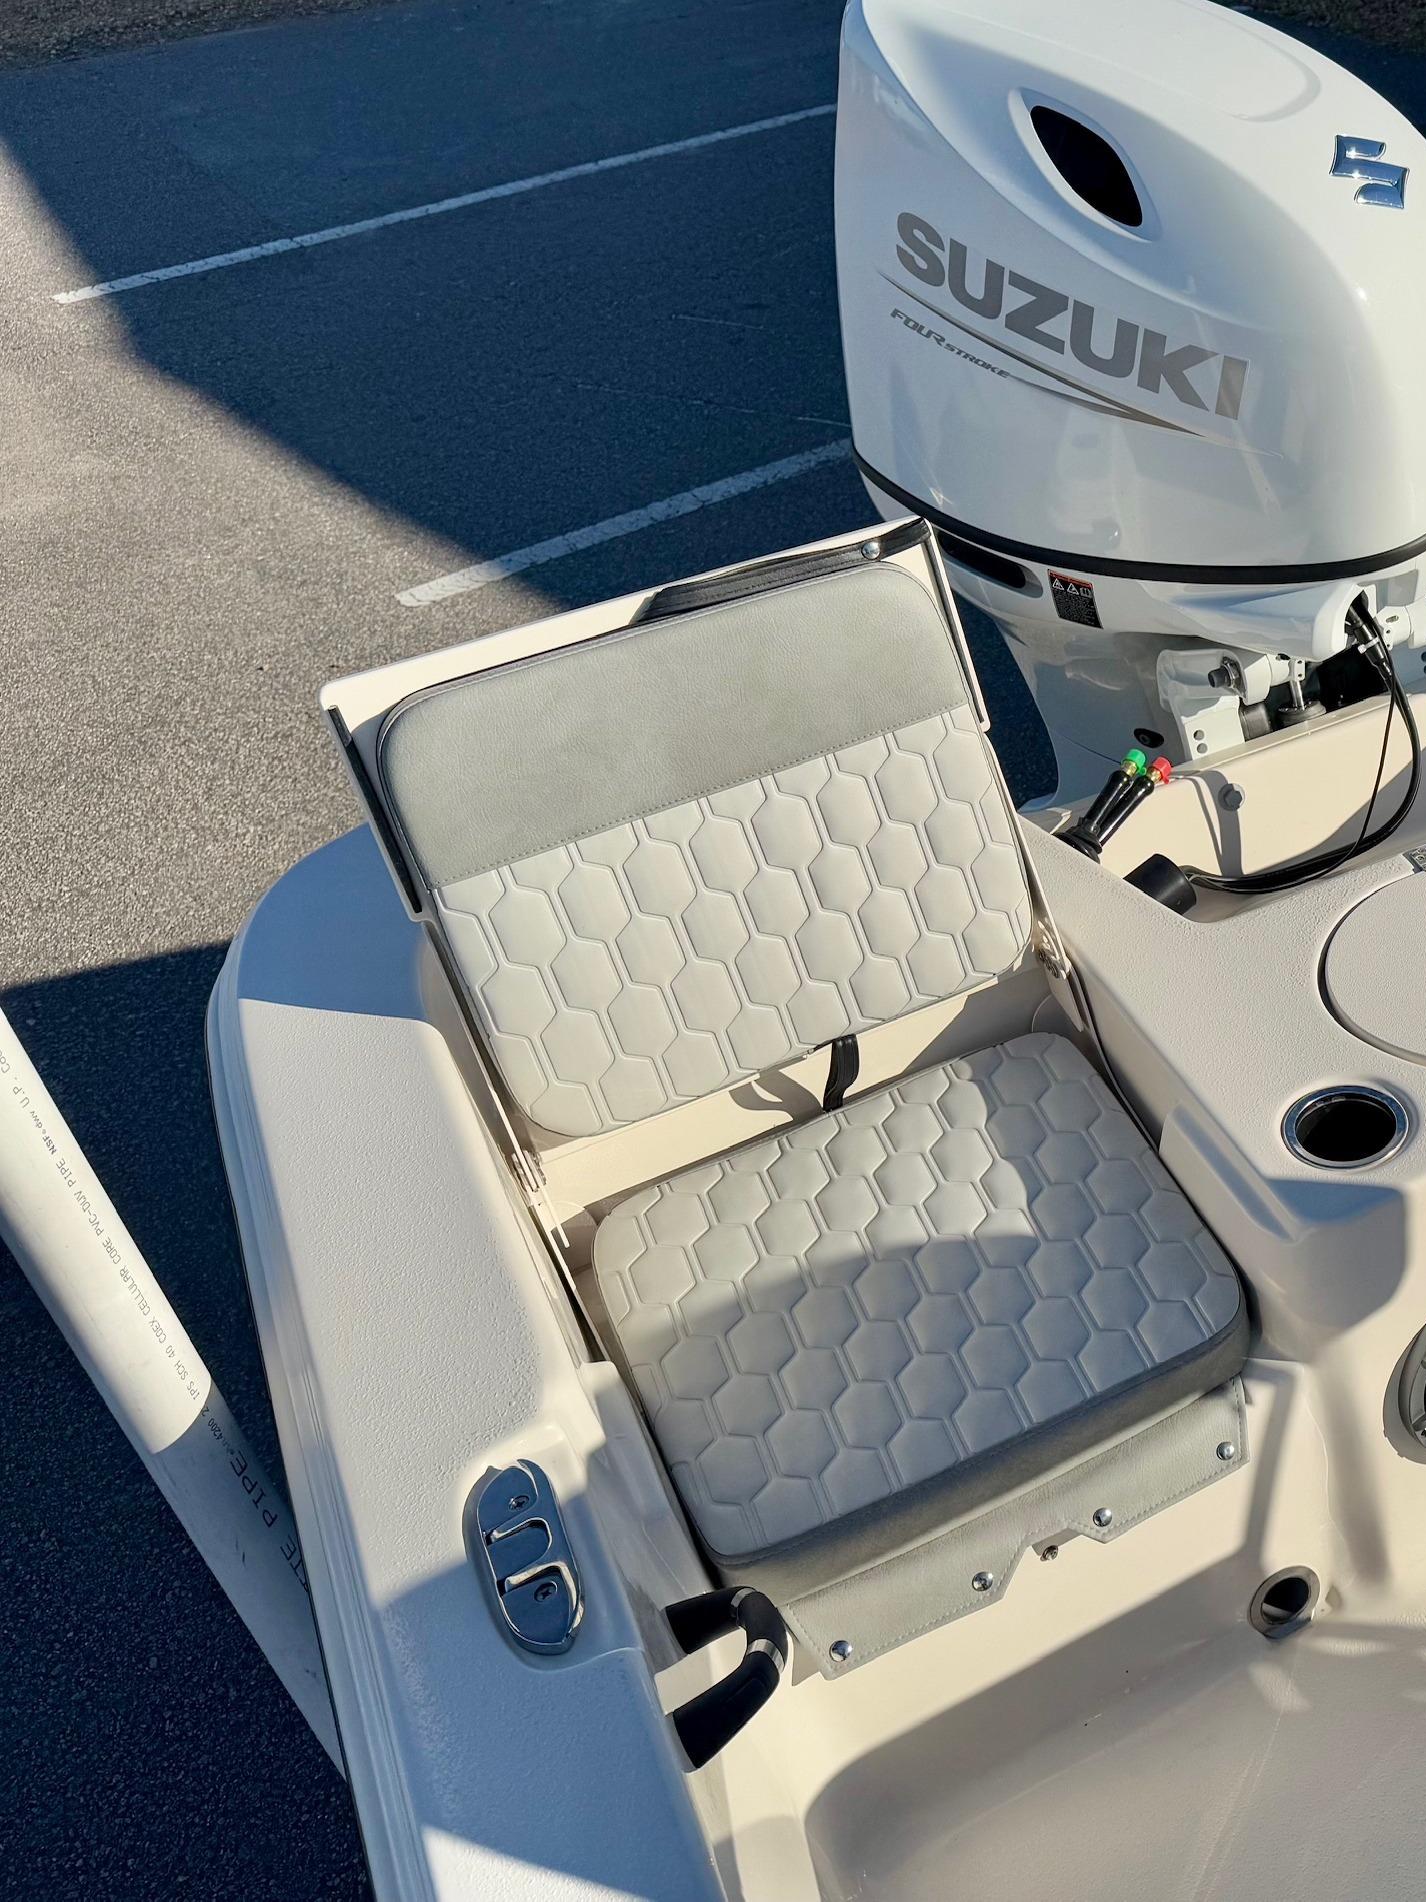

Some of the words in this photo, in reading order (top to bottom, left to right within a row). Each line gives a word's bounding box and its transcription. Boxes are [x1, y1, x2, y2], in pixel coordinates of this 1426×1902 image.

[894, 211, 1250, 421] SUZUKI
[56, 1158, 77, 1188] PIPE
[102, 1237, 122, 1265] CORE
[120, 1265, 151, 1317] CELLULAR
[148, 1317, 167, 1344] COEX
[165, 1344, 176, 1359] 40
[174, 1359, 189, 1381] SCH
[186, 1381, 200, 1401] IPS
[229, 1449, 278, 1529] PIPE
